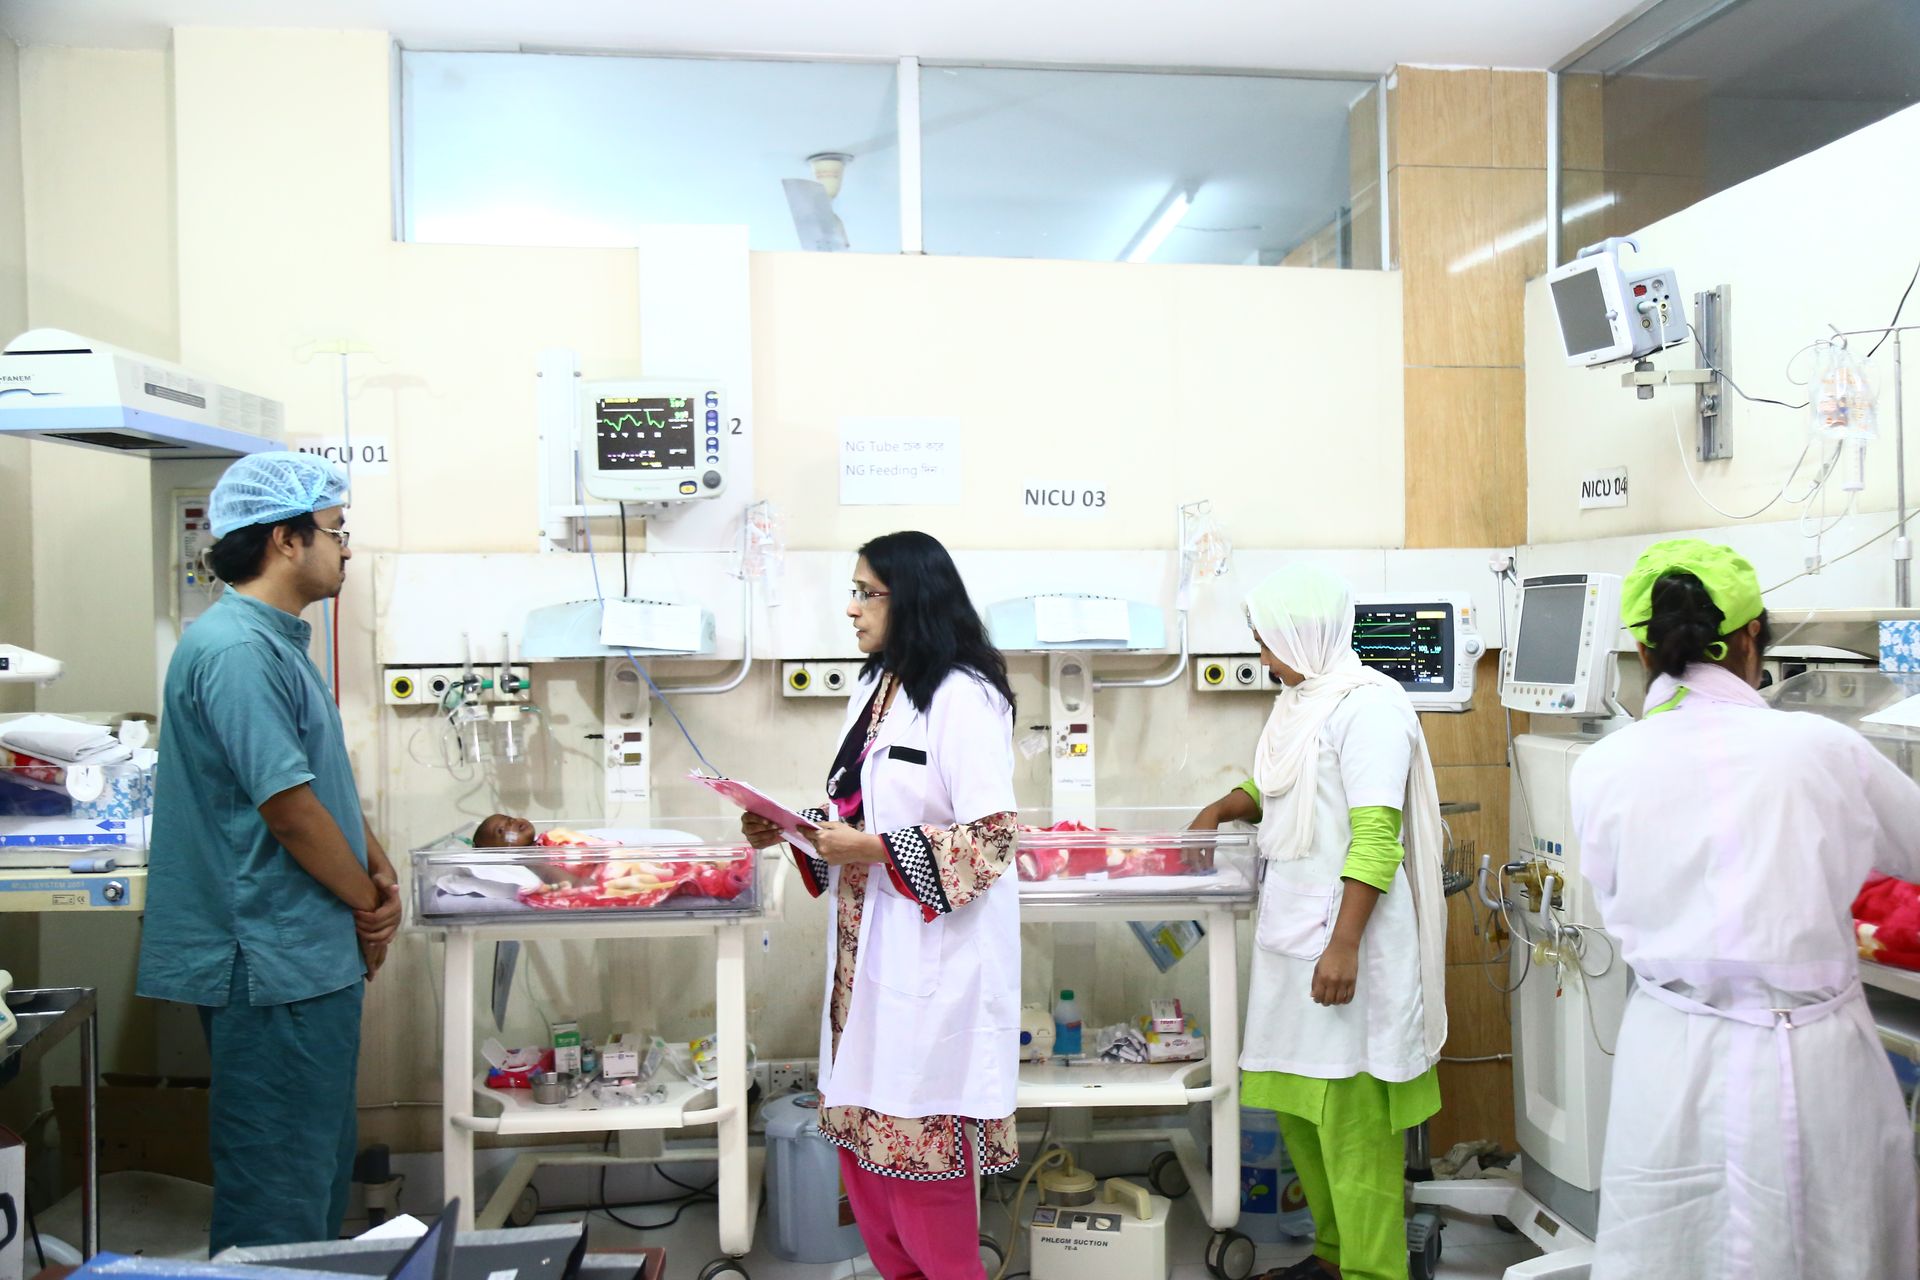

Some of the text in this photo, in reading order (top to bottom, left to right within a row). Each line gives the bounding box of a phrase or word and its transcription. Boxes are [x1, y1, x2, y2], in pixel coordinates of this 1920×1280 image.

[727, 417, 743, 435] 2
[362, 445, 389, 463] 01
[845, 440, 865, 452] NG
[869, 440, 900, 452] Tube
[845, 464, 865, 476] NG
[869, 464, 918, 479] Feeding
[1582, 477, 1628, 498] NICU 04
[1025, 489, 1106, 507] NICU 03
[1040, 1236, 1109, 1247] PHLEGM SUCTION
